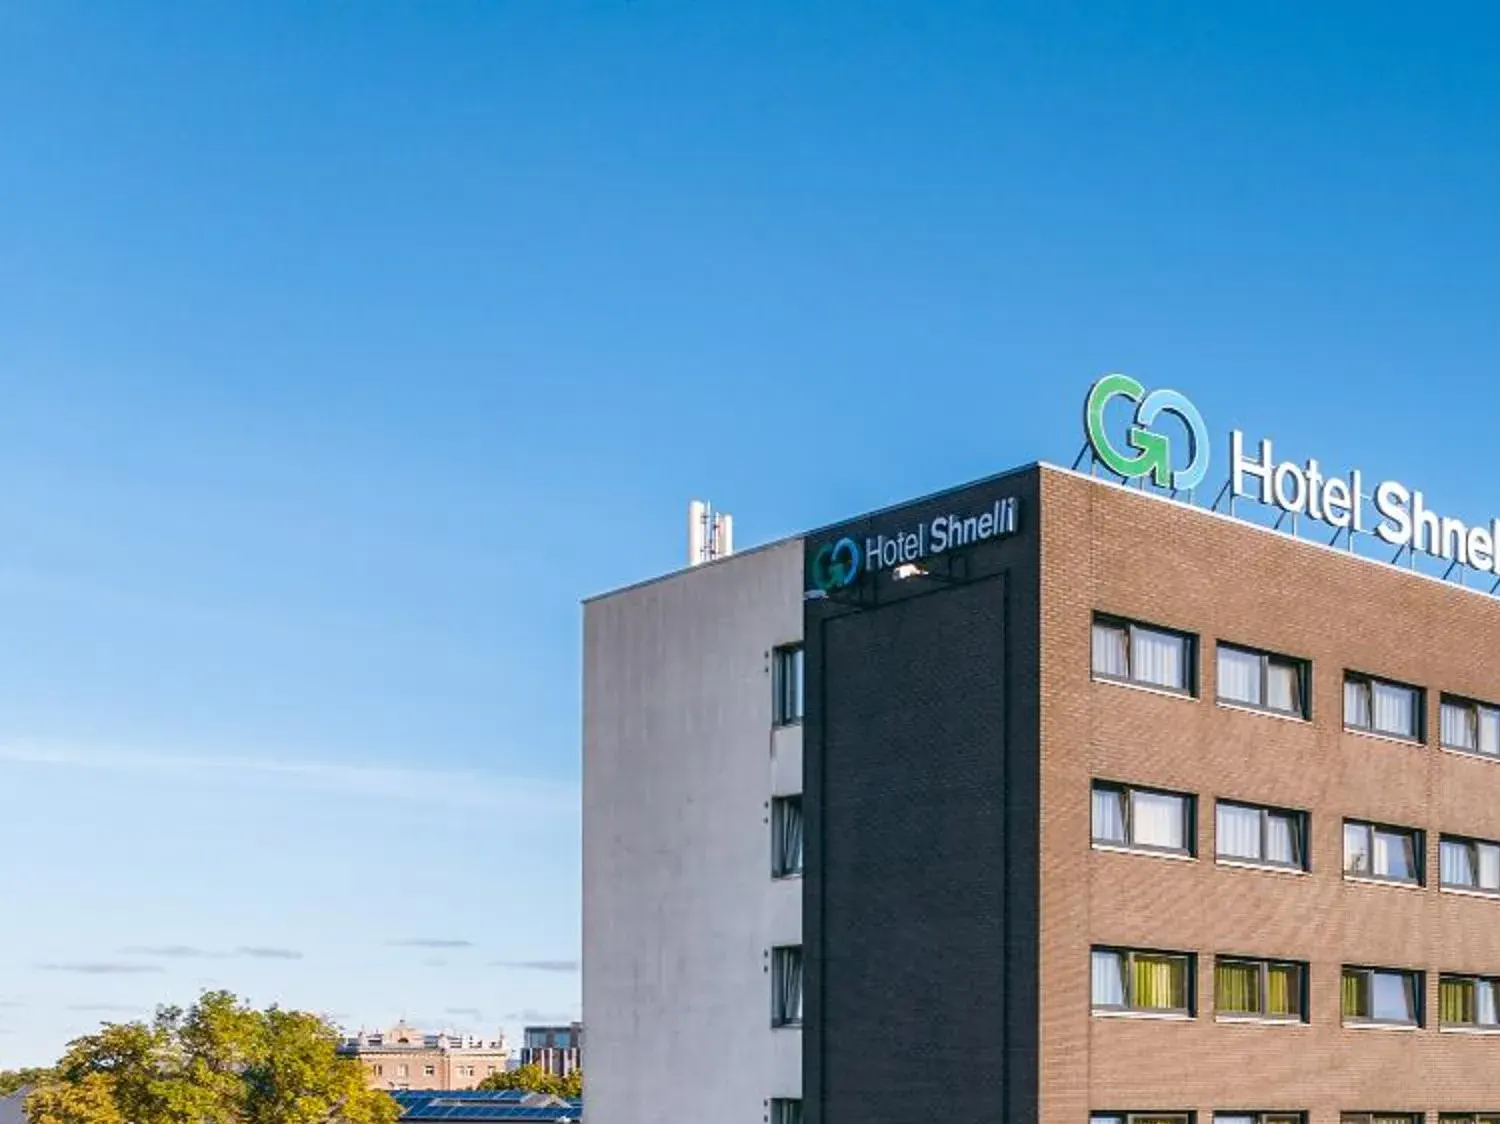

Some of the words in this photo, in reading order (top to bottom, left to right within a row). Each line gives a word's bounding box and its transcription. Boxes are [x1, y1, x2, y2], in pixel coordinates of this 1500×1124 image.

[1230, 430, 1362, 530] Hotel
[865, 524, 924, 571] Hotel
[930, 497, 1019, 553] Shnelli
